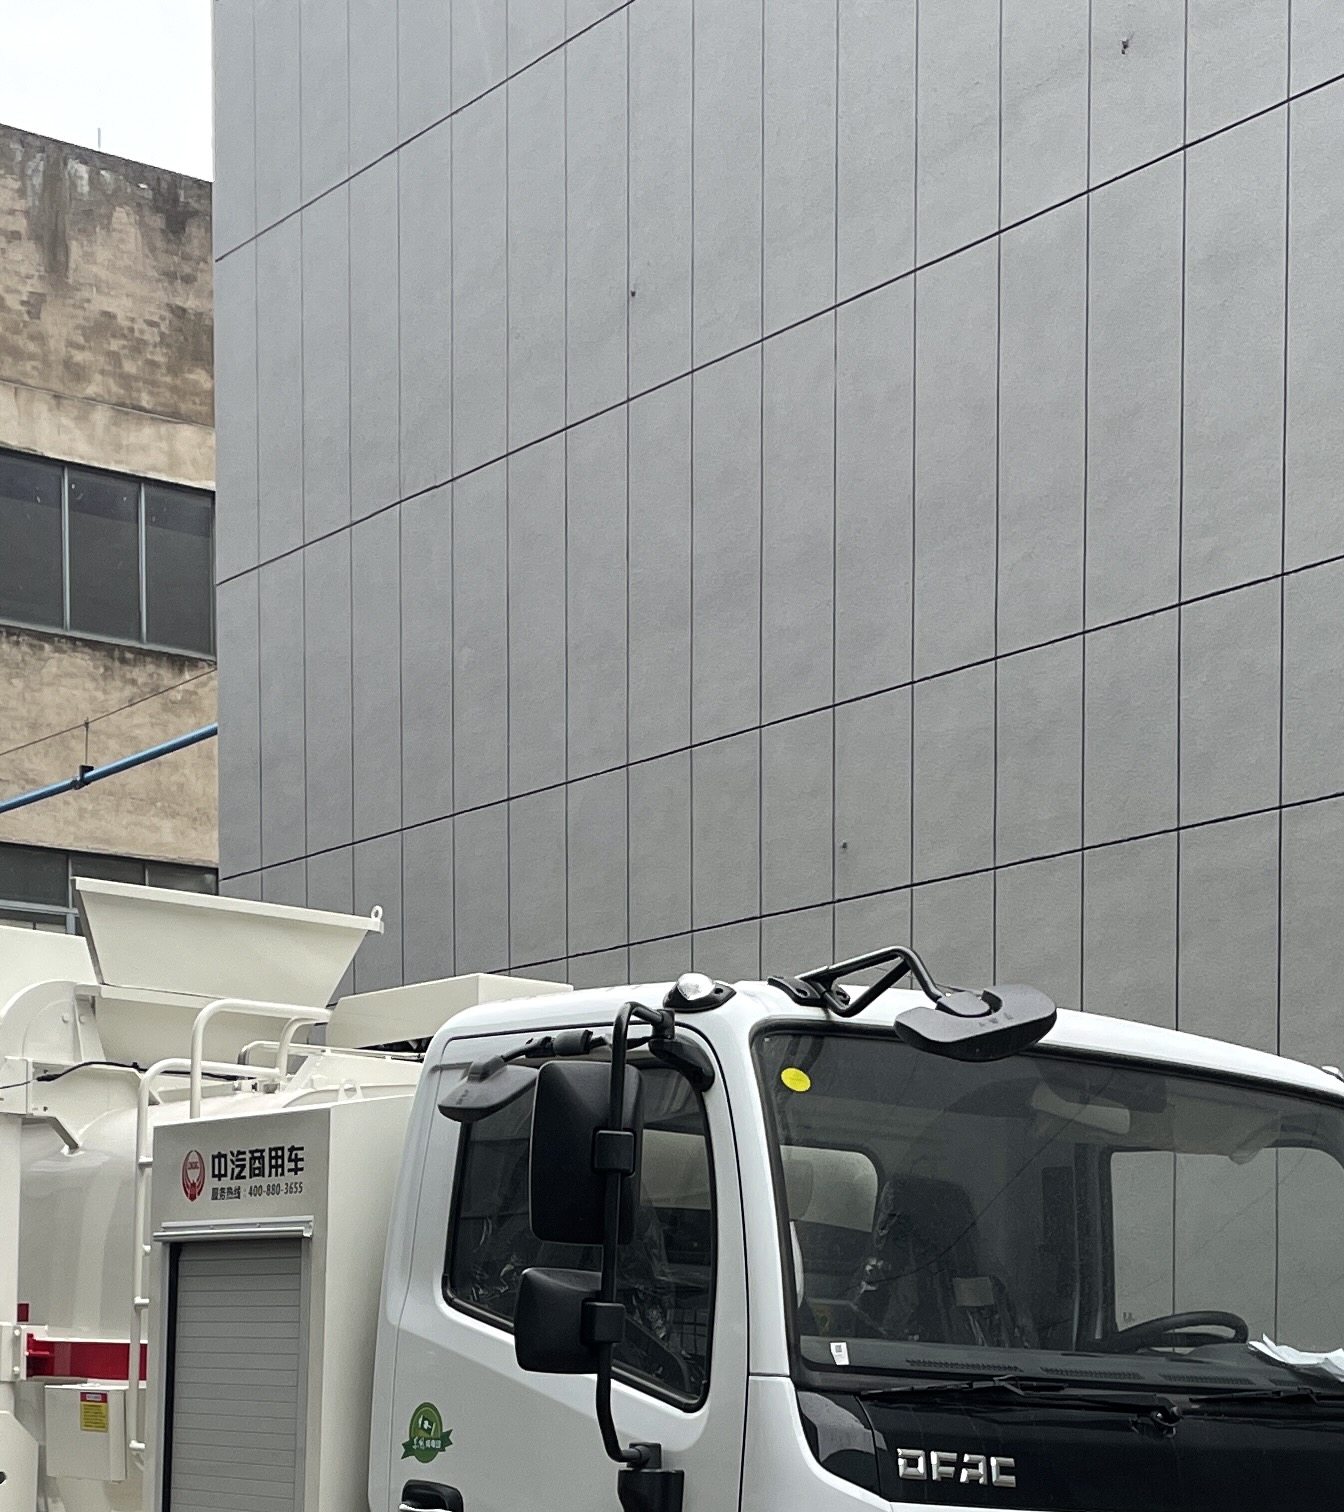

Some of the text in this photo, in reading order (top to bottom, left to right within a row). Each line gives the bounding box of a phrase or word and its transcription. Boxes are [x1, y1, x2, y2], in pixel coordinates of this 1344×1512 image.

[211, 1145, 305, 1181] 中汽商用车
[896, 1448, 1017, 1488] DFAC
